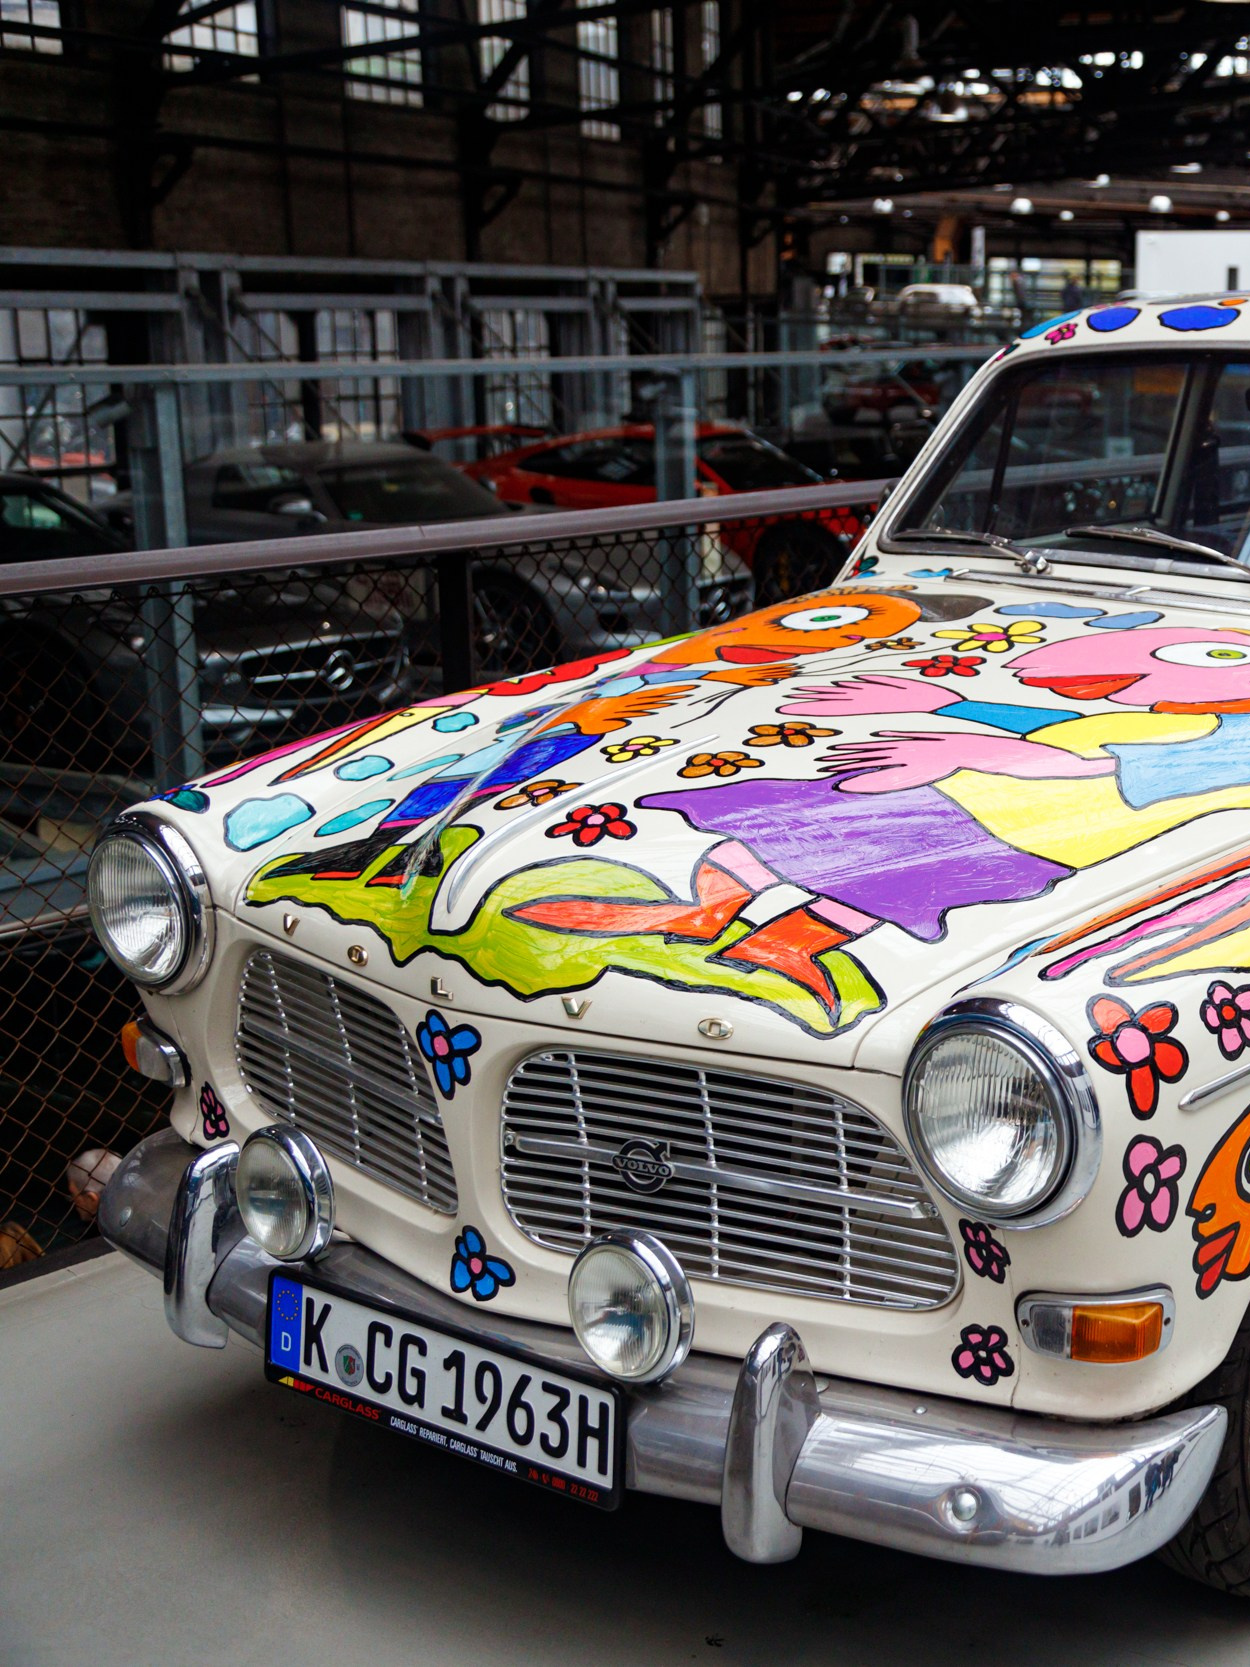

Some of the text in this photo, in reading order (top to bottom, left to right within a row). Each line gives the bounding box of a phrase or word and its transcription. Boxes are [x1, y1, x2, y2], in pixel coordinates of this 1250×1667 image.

[614, 1156, 670, 1176] VOLVO
[281, 1332, 292, 1352] D
[303, 1296, 608, 1476] K CG 1963H
[315, 1388, 380, 1420] CARGLASS
[419, 1427, 448, 1447] REPARIERT,
[480, 1449, 504, 1467] TAUSCHT
[504, 1460, 518, 1473] AUS.
